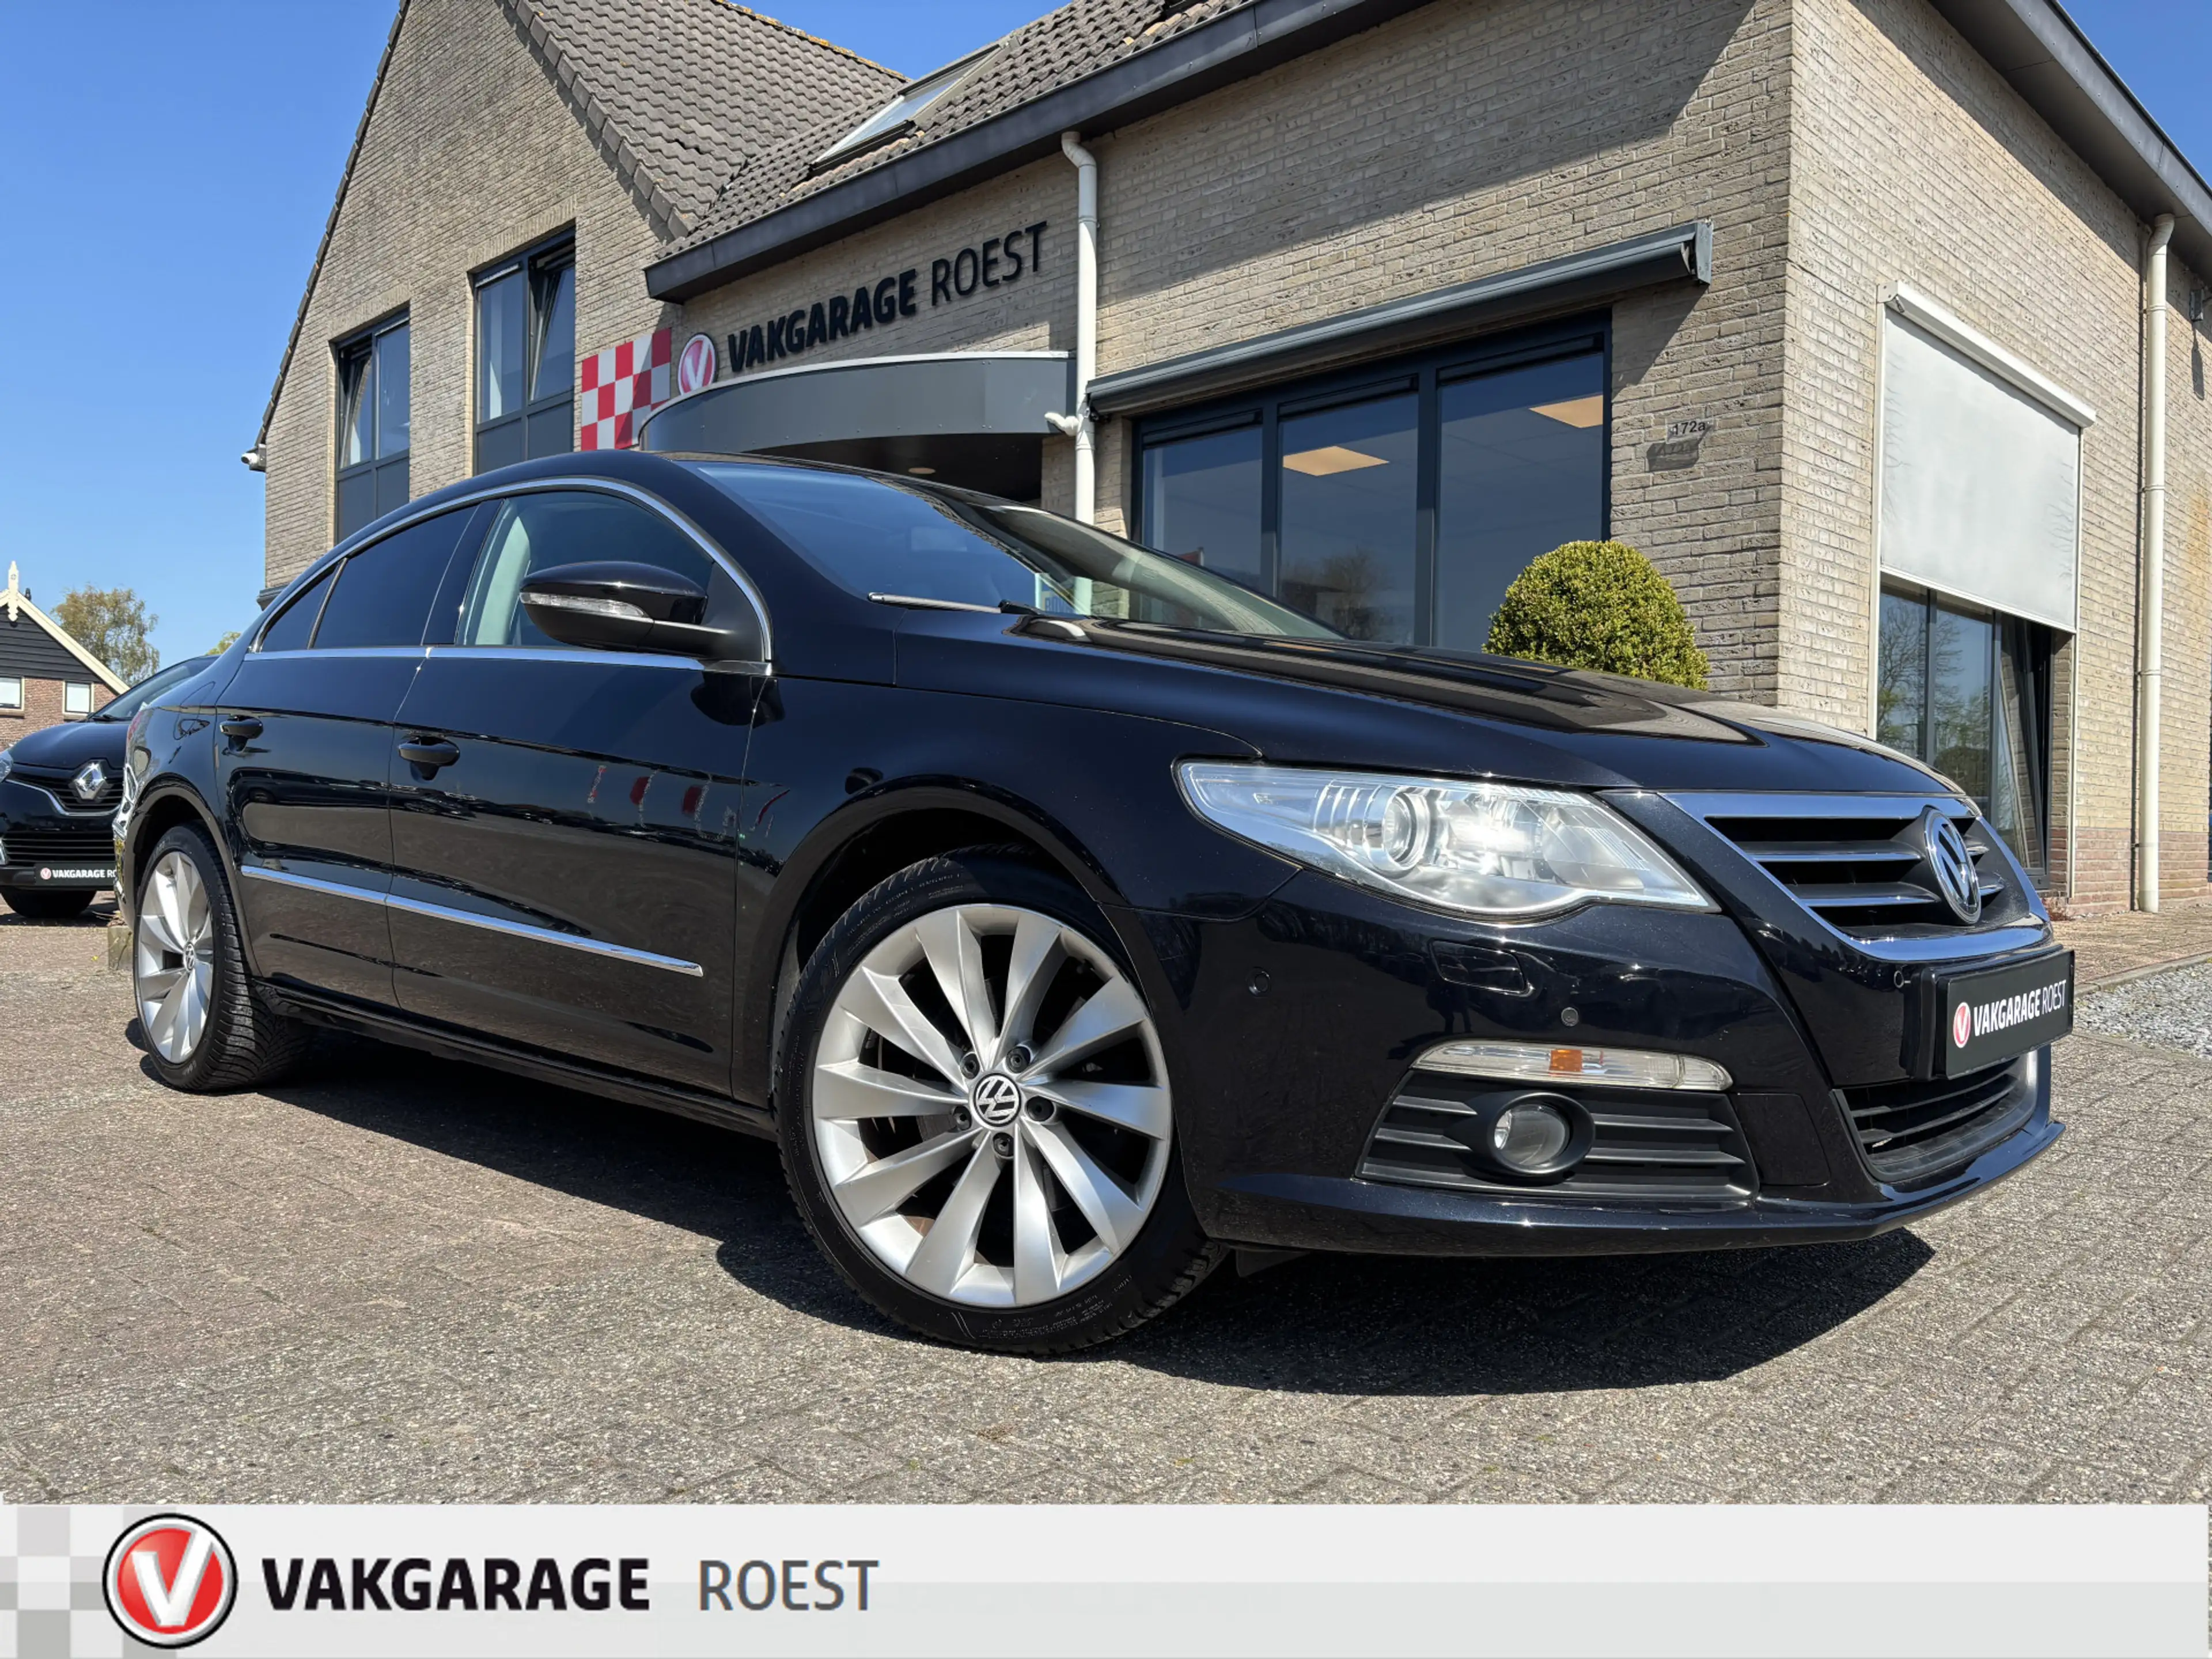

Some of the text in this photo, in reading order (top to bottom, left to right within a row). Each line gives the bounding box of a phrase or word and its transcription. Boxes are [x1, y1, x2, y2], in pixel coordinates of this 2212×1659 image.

[728, 268, 916, 372] VAKGARAGE
[931, 221, 1048, 306] ROEST
[1673, 421, 1706, 435] 172a
[52, 869, 105, 878] VAKGARAGE
[1974, 988, 2041, 1036] VAKGARAGE
[2042, 979, 2067, 1015] ROEST
